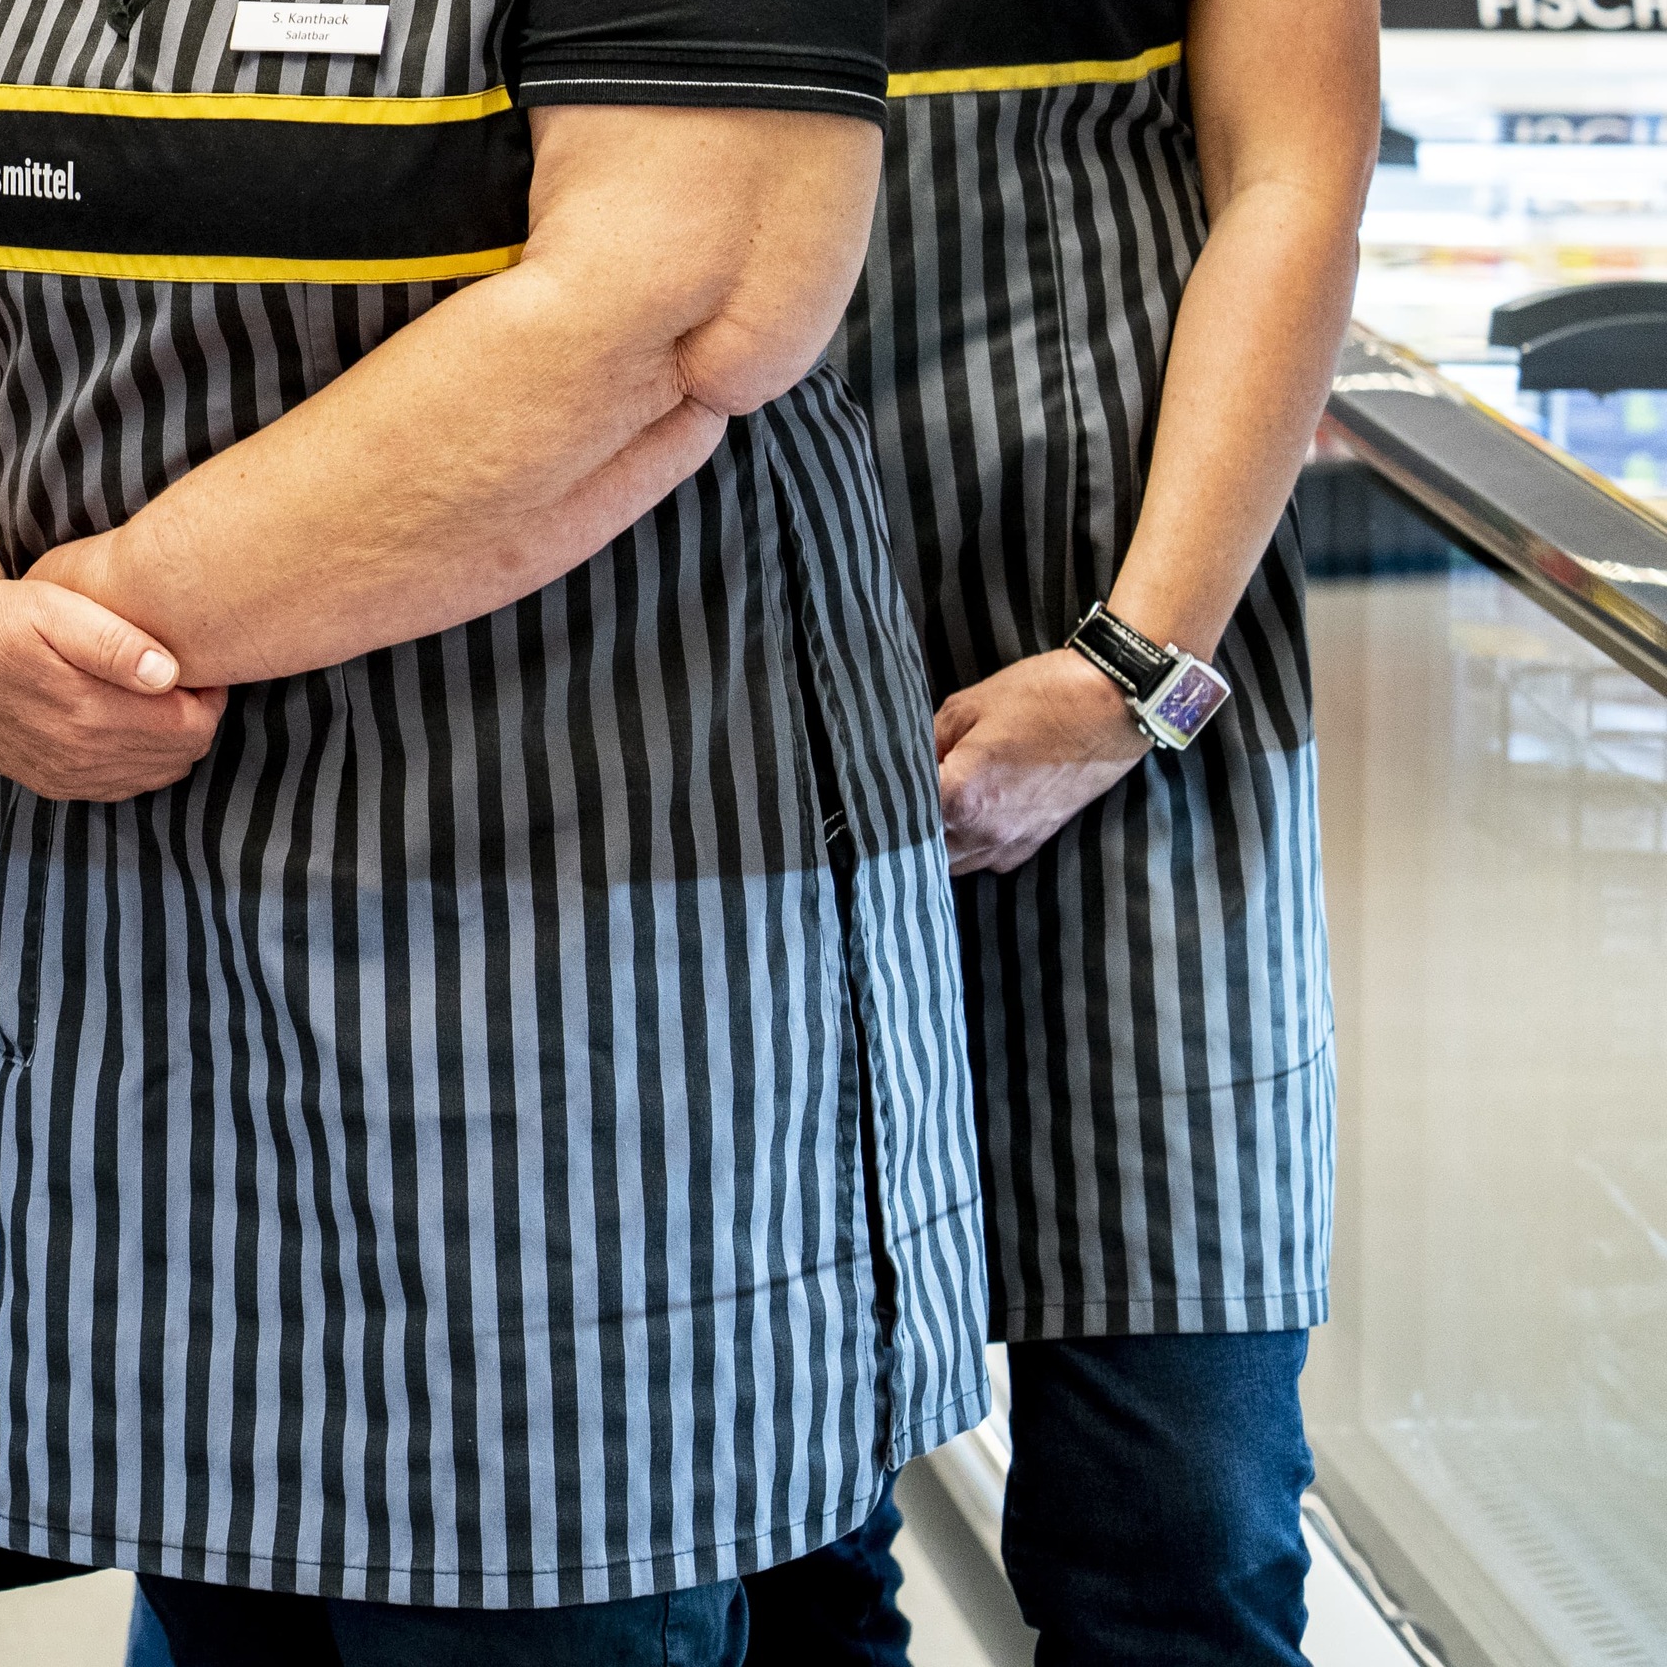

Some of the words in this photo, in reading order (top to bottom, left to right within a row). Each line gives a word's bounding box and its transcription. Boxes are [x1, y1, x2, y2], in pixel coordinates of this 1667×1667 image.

[272, 12, 283, 24] S.
[288, 12, 350, 26] Kanthack
[285, 30, 330, 41] Salatbar
